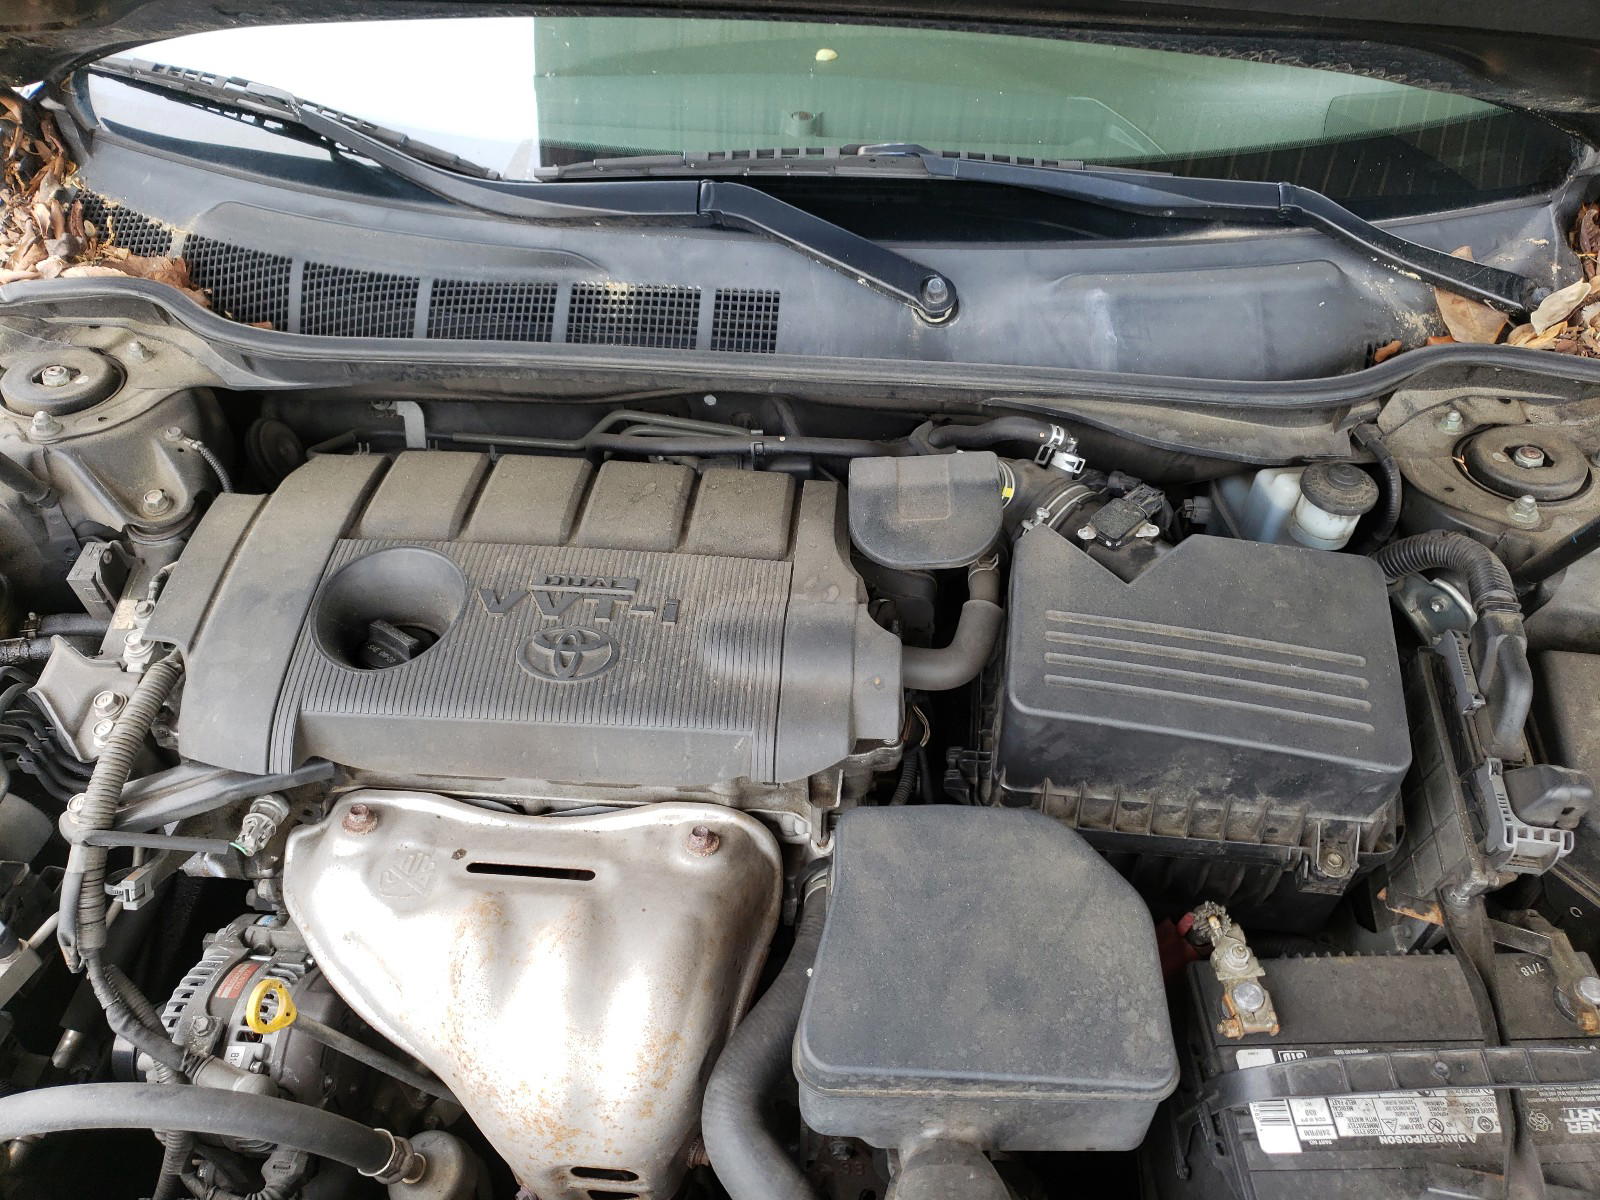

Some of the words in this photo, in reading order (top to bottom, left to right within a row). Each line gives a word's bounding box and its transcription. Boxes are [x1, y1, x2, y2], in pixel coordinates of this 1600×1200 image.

[544, 575, 627, 589] DUAL
[1520, 962, 1545, 977] 7/18
[1379, 1134, 1467, 1145] DANGER/POISON
